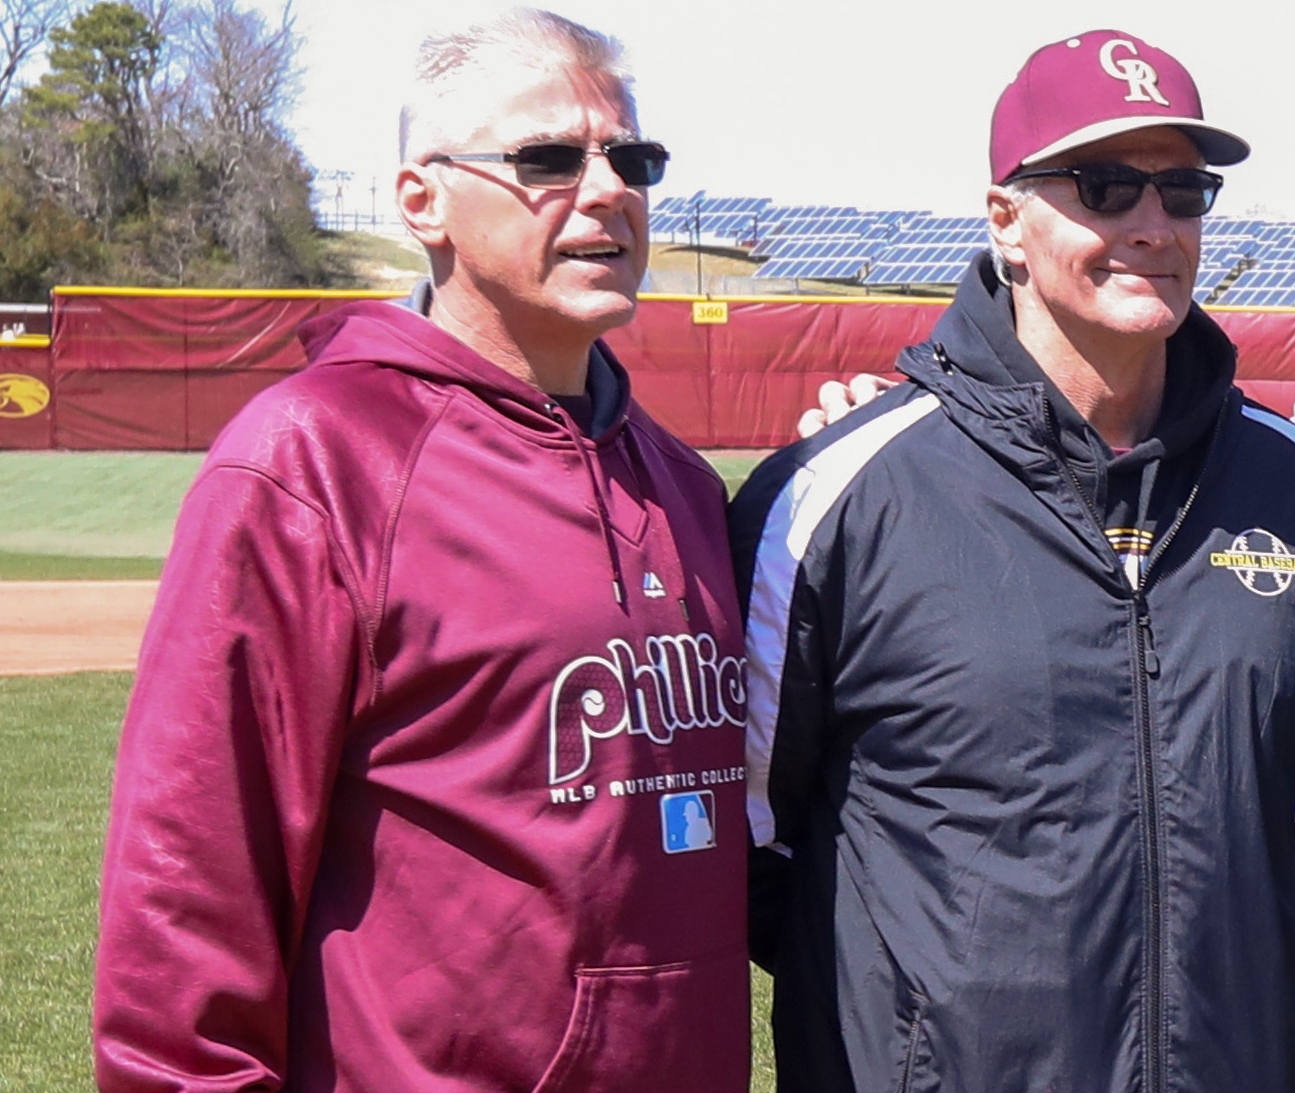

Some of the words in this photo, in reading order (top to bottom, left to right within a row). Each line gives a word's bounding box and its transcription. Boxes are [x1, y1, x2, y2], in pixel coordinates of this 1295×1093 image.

[1099, 39, 1170, 106] CR
[698, 307, 722, 318] 360
[1210, 552, 1259, 567] CENTRAL
[550, 784, 596, 804] MLB
[609, 771, 696, 797] AUTHENTIC
[701, 766, 747, 785] COLLEC
